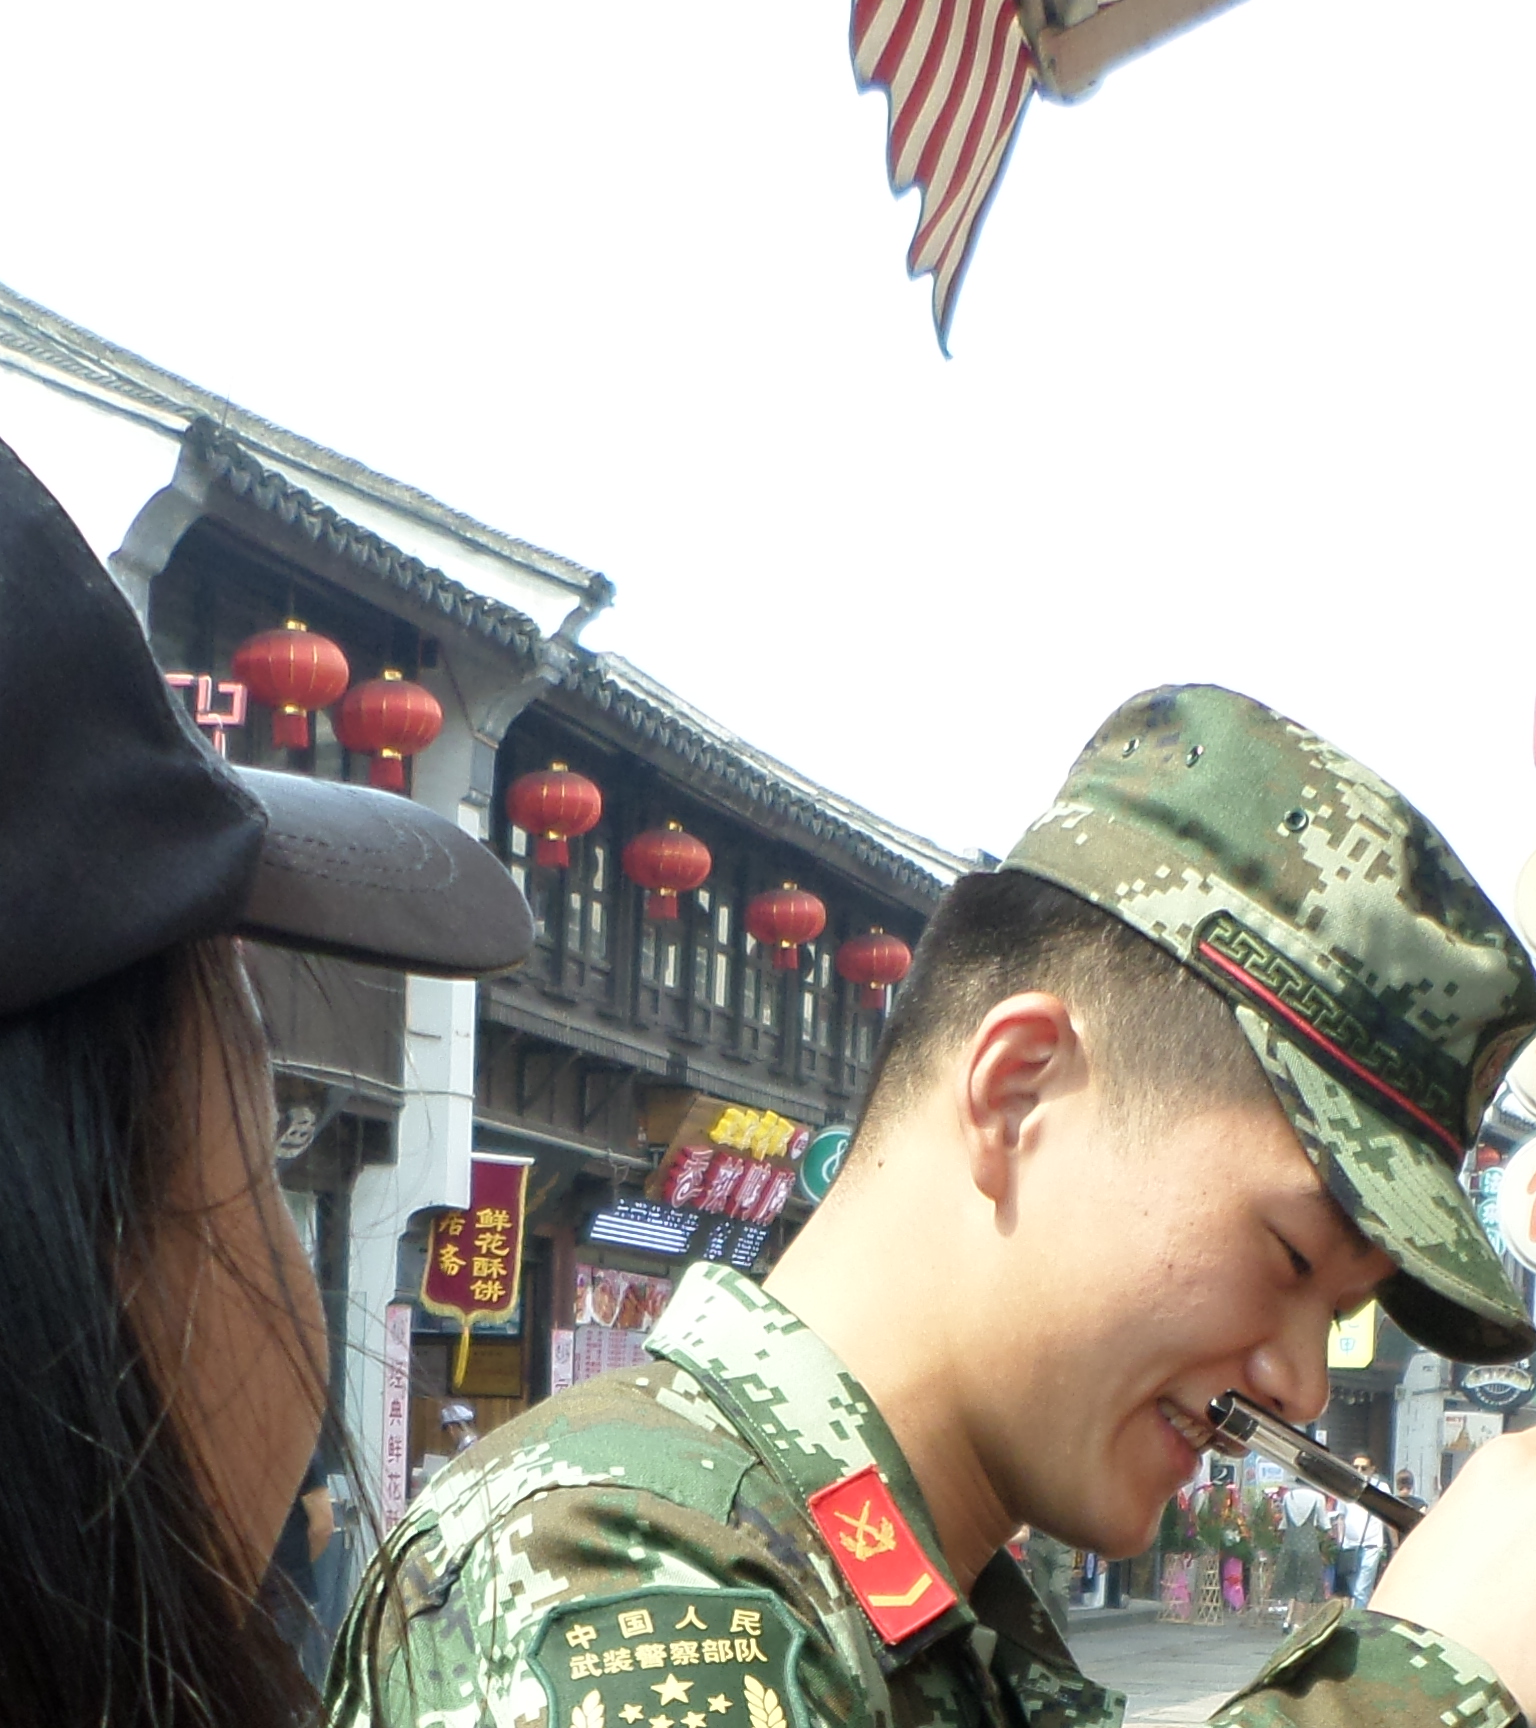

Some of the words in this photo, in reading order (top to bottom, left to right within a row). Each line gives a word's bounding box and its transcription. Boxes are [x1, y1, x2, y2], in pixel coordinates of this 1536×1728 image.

[470, 1208, 512, 1303] 鲜花酥饼
[565, 1605, 763, 1650] 中国人民
[569, 1637, 768, 1680] 武装警察部队
